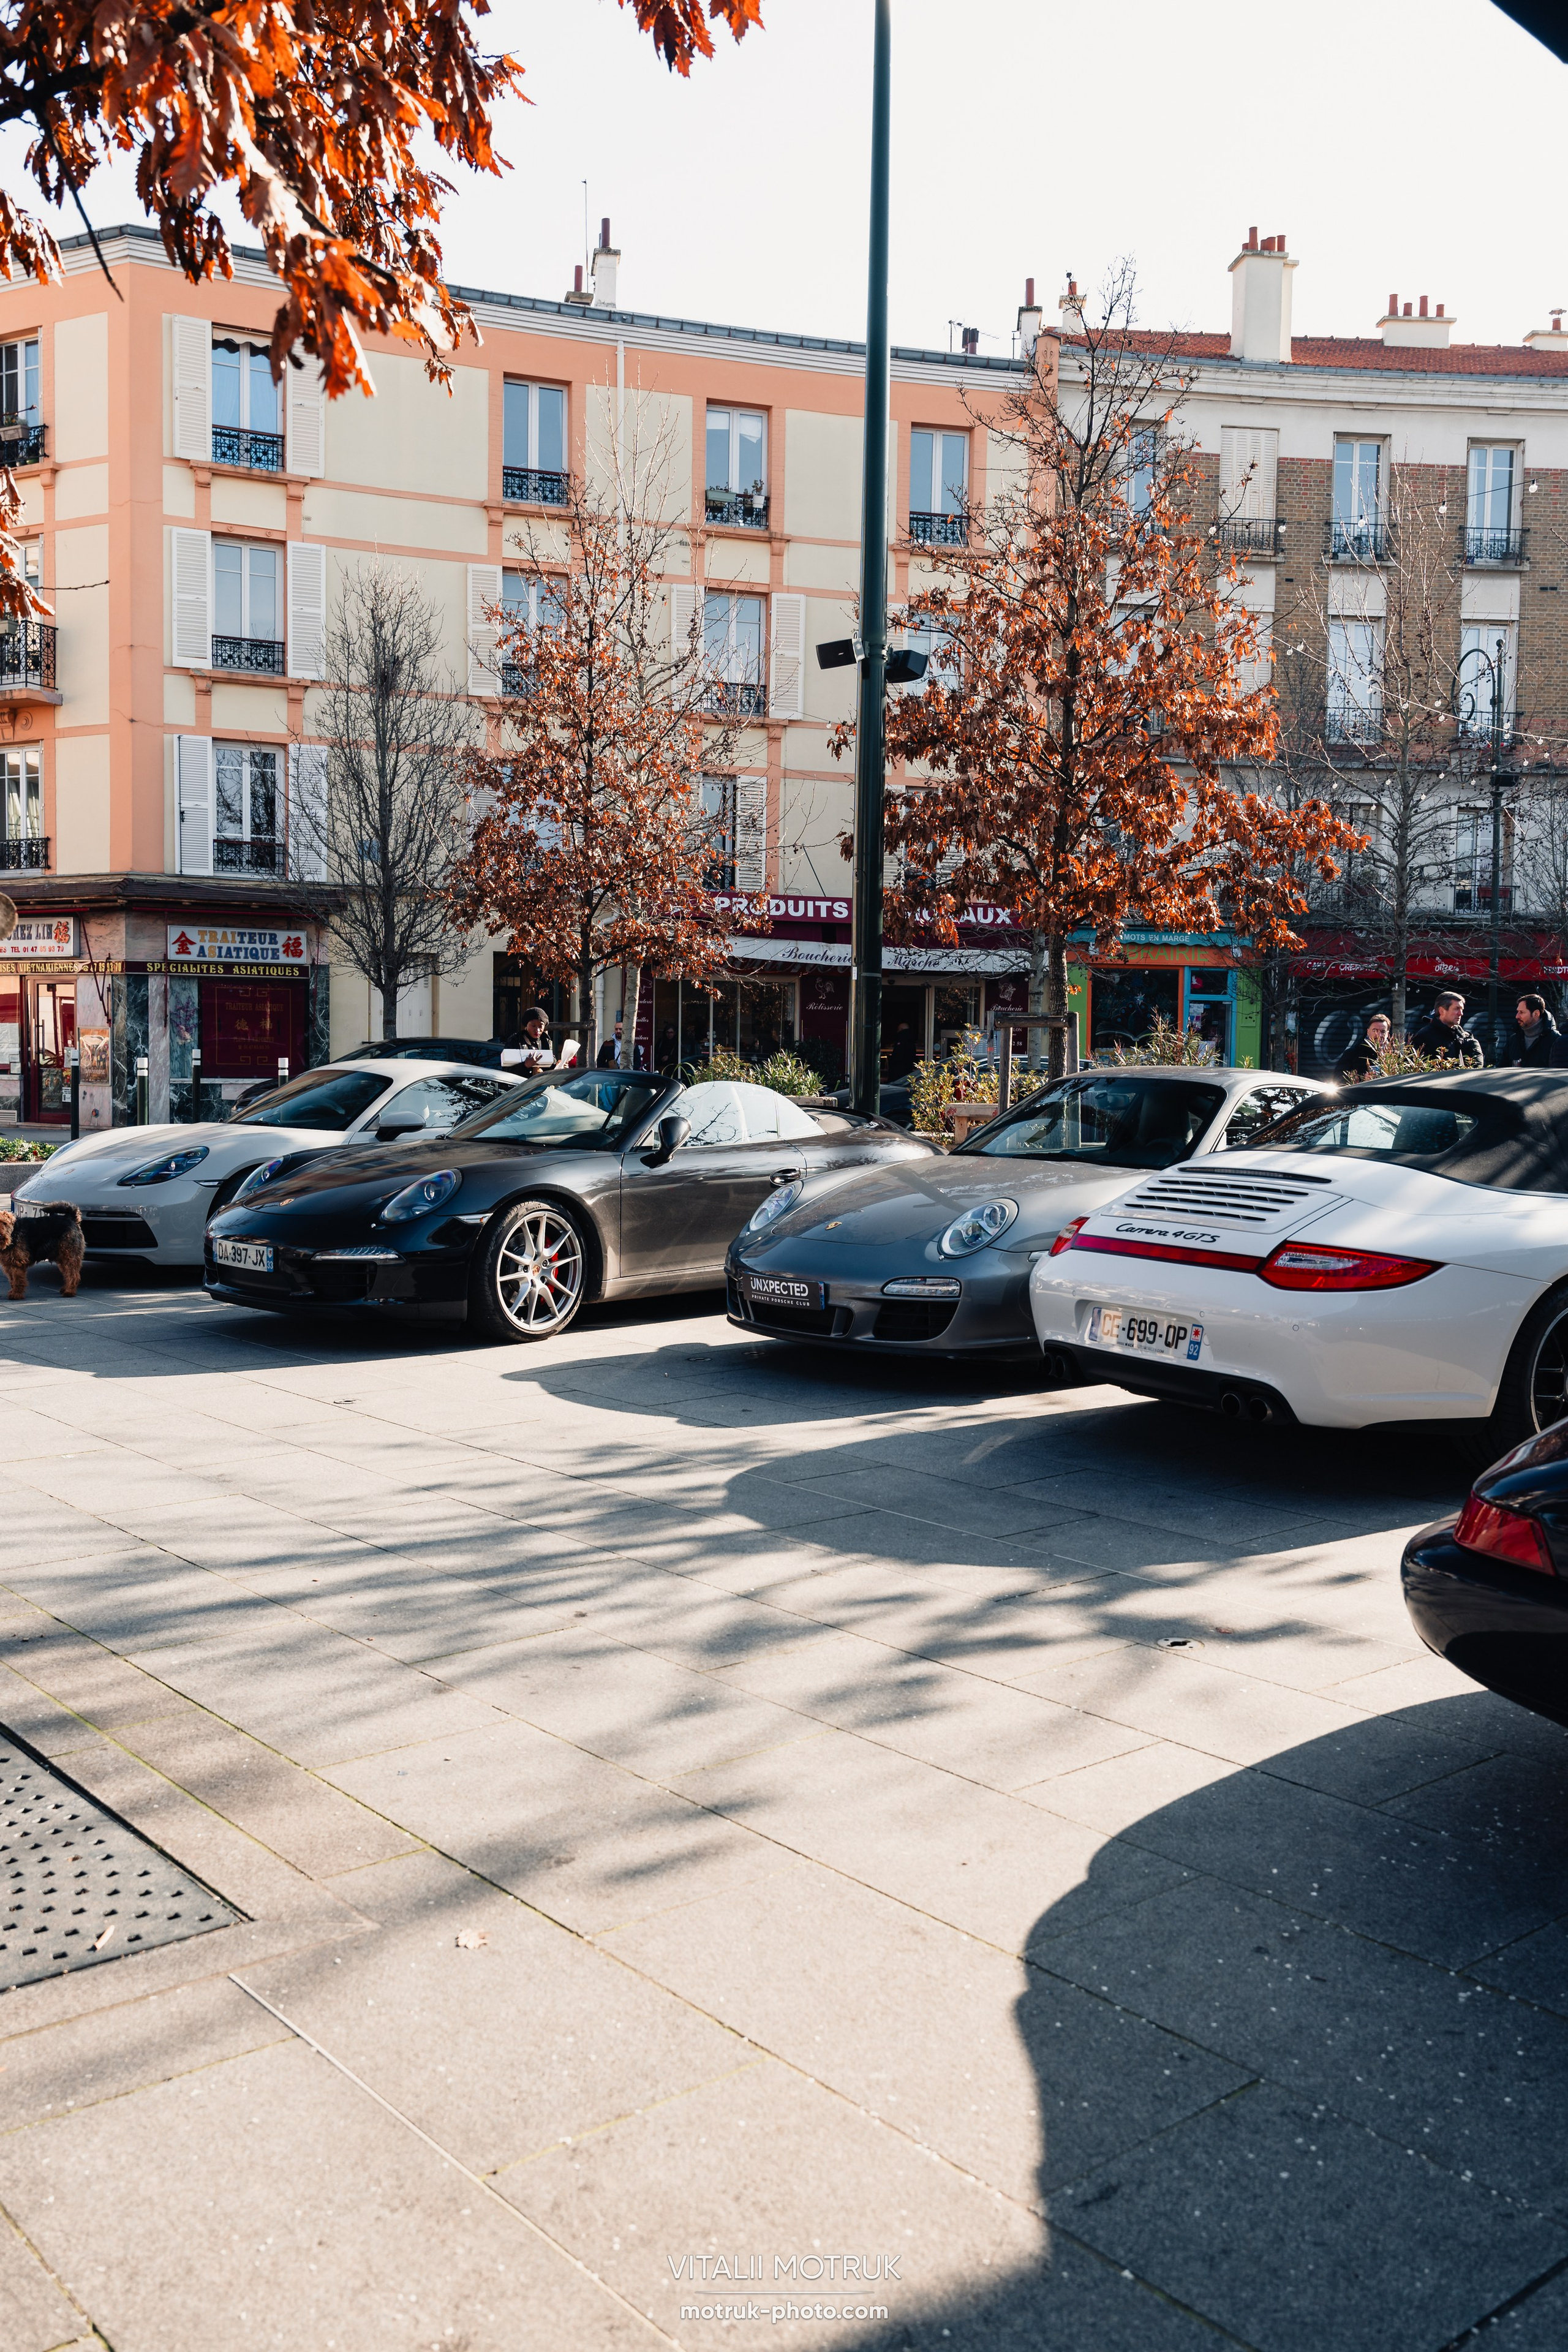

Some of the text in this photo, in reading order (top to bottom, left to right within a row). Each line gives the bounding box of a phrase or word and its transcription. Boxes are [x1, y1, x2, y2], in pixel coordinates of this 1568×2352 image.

[715, 897, 848, 918] PRODUITS
[7, 924, 53, 941] HEZ LIN
[53, 921, 70, 944] 福
[197, 930, 278, 945] TRAITEUR
[172, 930, 197, 956] 金
[282, 935, 304, 959] 福
[197, 945, 280, 960] ASIATIQUE
[782, 945, 852, 963] Boucherie
[19, 962, 78, 973] VIETNAMIENNES
[115, 962, 122, 972] 70
[146, 962, 300, 976] SPECIALITES ASIATIQUES
[225, 1002, 252, 1011] TRAITEUR
[805, 1001, 843, 1011] Rôtisserie
[990, 1003, 1023, 1012] Boucherie
[1115, 1223, 1169, 1237] Carrera
[218, 1243, 265, 1267] DA-397-JX
[266, 1261, 274, 1270] 33
[750, 1277, 809, 1297] UNXPECTED
[1102, 1313, 1188, 1349] CE-699-QP
[1188, 1343, 1199, 1356] 92
